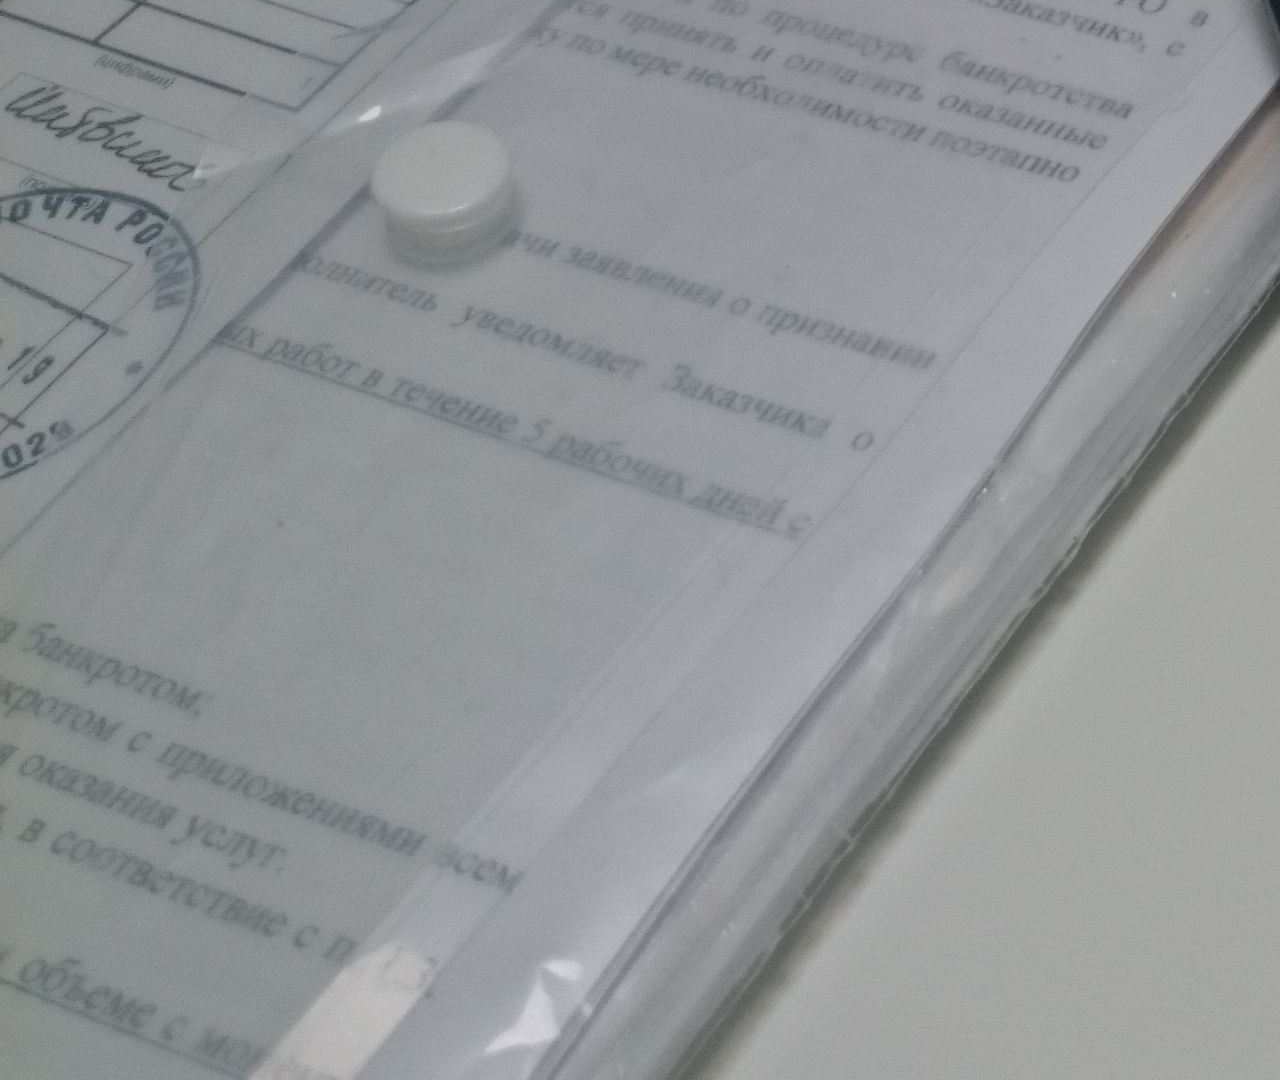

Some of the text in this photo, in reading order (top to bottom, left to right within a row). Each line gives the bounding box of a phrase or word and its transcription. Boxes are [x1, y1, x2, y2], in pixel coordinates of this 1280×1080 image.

[607, 42, 682, 78] мере
[928, 127, 1082, 185] поэтапно
[749, 44, 777, 64] и
[937, 92, 1110, 152] оказанные
[937, 48, 1136, 121] банкротства
[0, 194, 111, 224] ОЧТА
[562, 243, 724, 309] заявления
[728, 295, 753, 317] о
[258, 334, 363, 383] работ
[361, 366, 386, 390] в
[388, 373, 521, 438] течение
[520, 416, 556, 445] 5
[541, 431, 692, 498] рабочих
[848, 428, 877, 454] о
[18, 753, 179, 830] оказания
[126, 730, 154, 753] с
[156, 741, 429, 858] приложениями
[16, 817, 47, 845] в
[50, 830, 289, 938] соответствие
